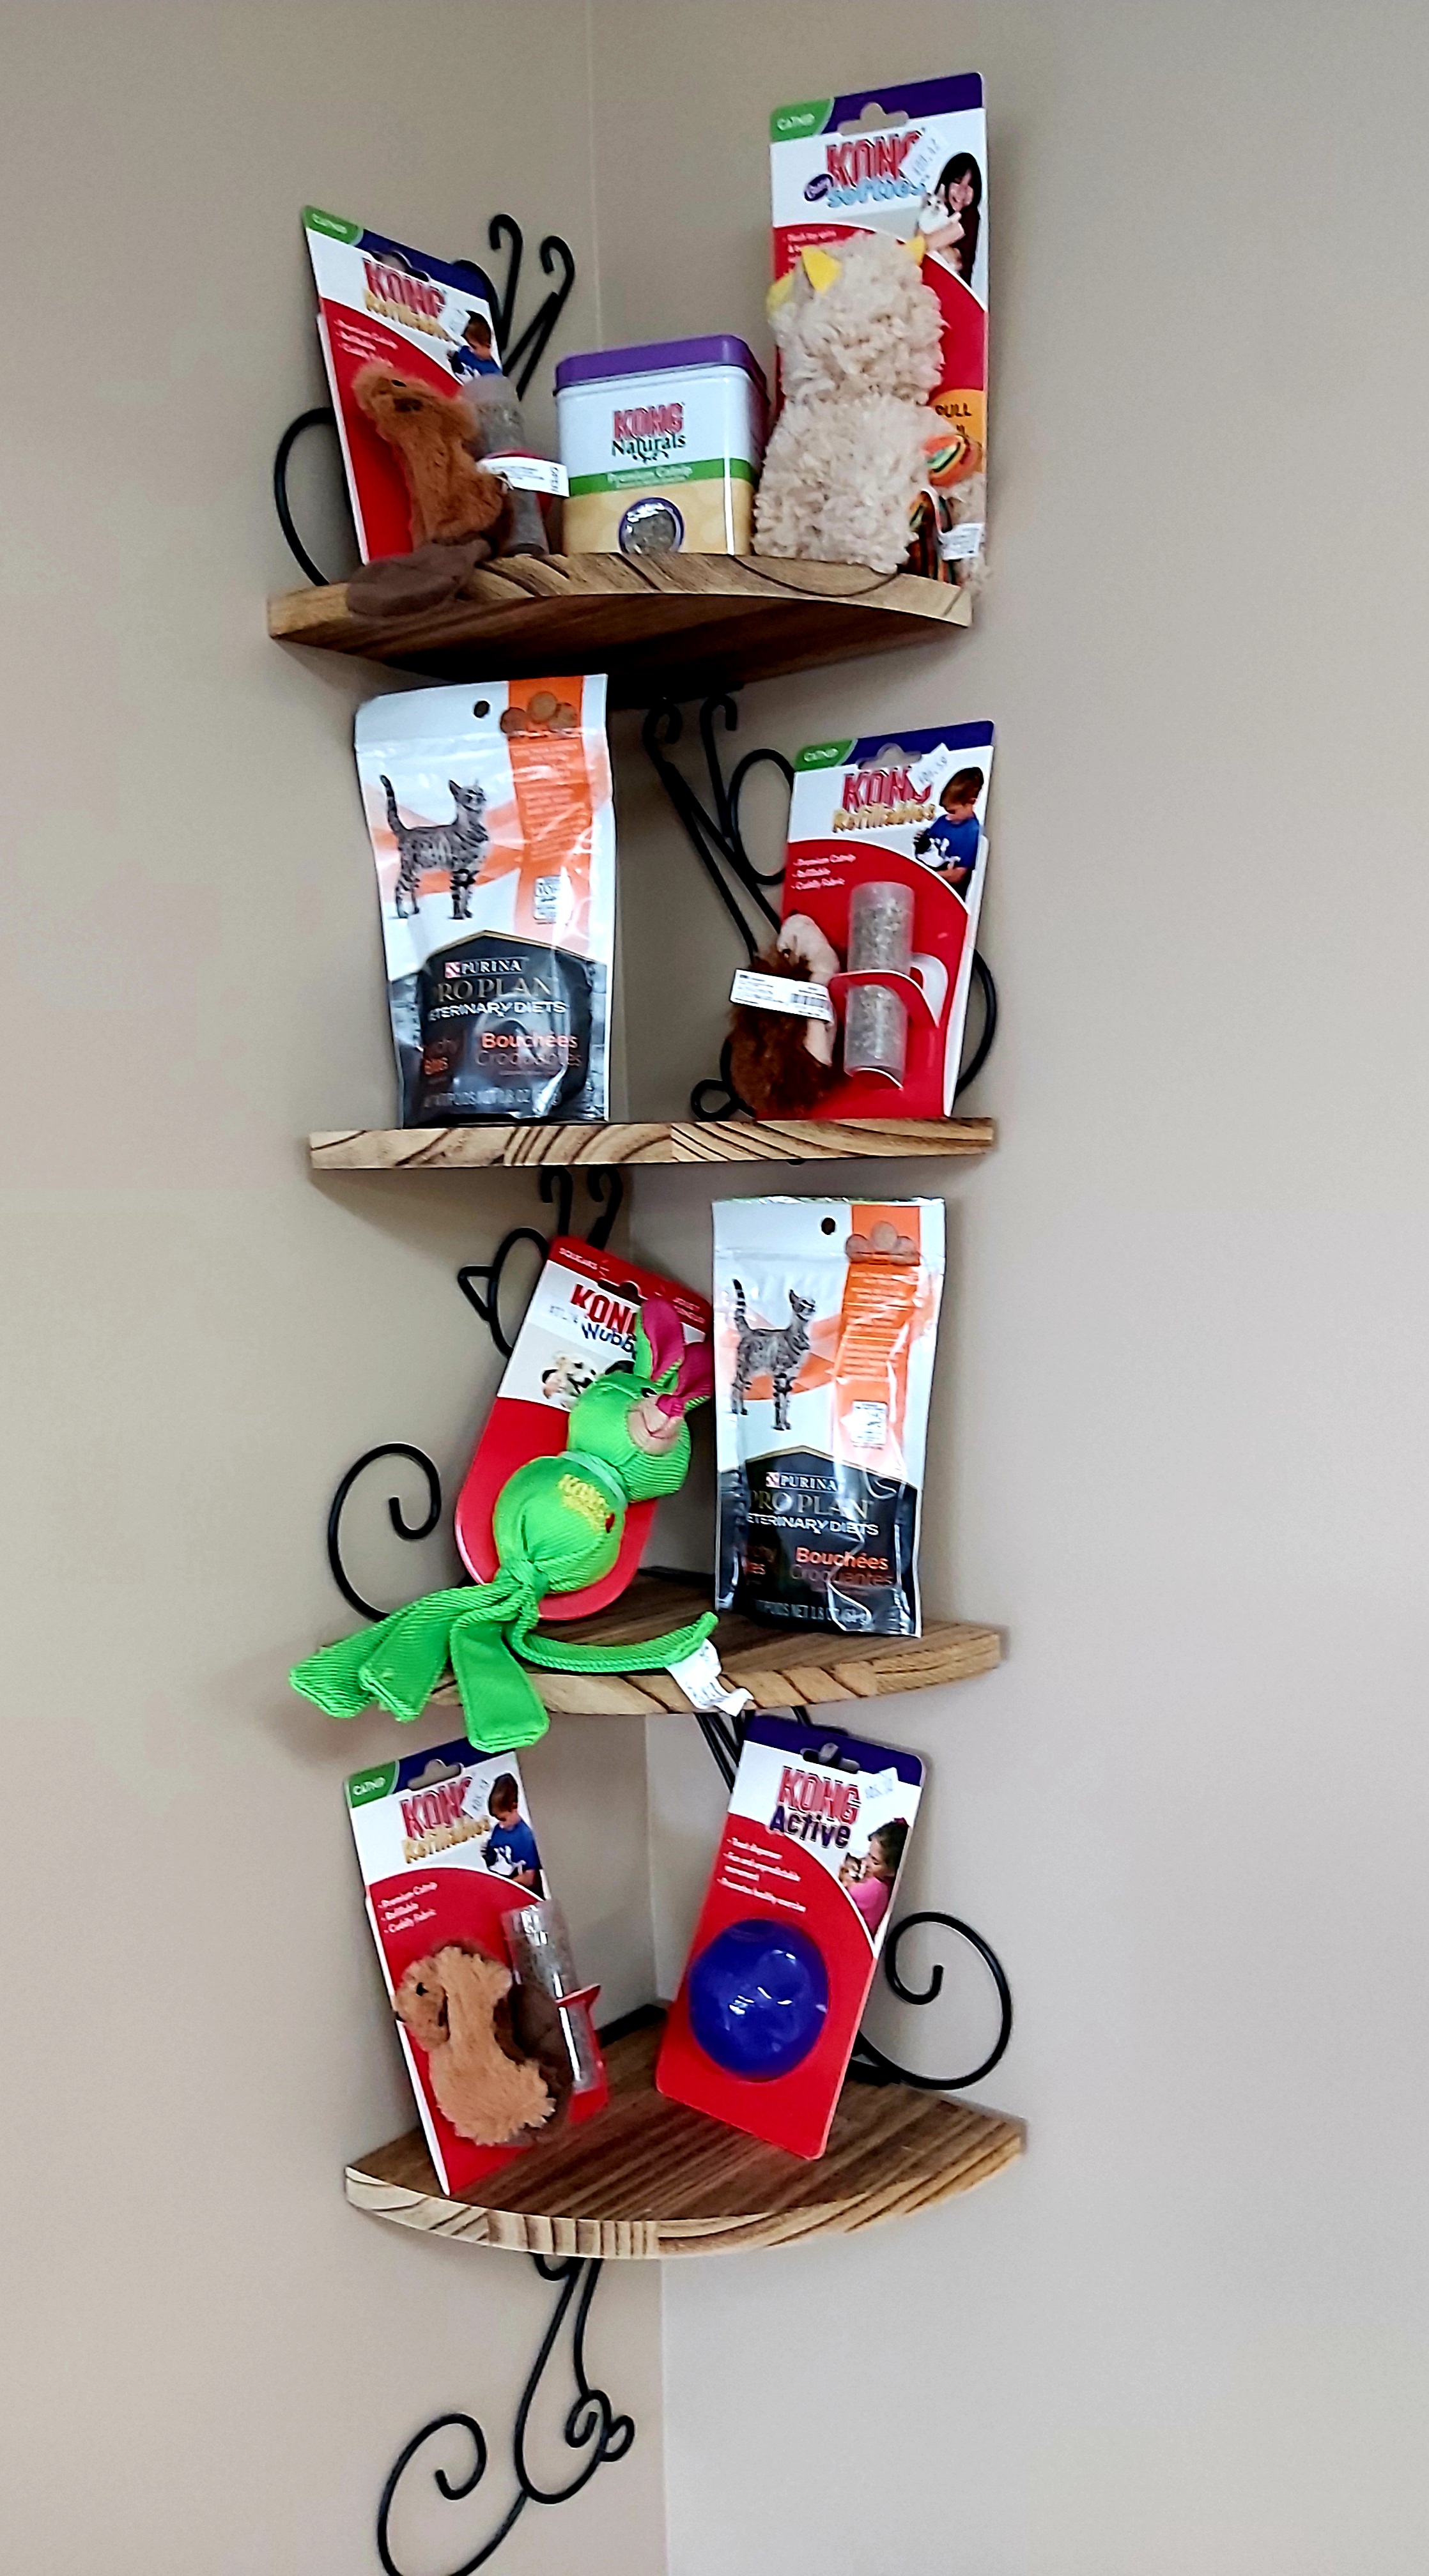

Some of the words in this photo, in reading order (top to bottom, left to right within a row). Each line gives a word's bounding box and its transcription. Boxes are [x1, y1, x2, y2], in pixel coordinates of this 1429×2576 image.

[614, 402, 685, 441] KONG
[611, 433, 687, 457] Naturals
[461, 959, 523, 975] PURINA
[436, 978, 473, 1004] RO
[428, 1001, 513, 1022] ETERINARY
[514, 1000, 569, 1014] DIETS
[482, 1031, 578, 1050] Bouchées
[569, 1283, 637, 1336] KON
[581, 1322, 637, 1360] Wubb
[780, 1475, 838, 1491] PURINA
[746, 1512, 829, 1535] ETERINARY
[829, 1521, 880, 1537] DIETS
[796, 1546, 889, 1571] Bouchées
[776, 1765, 862, 1826] KONG
[768, 1805, 852, 1848] Active
